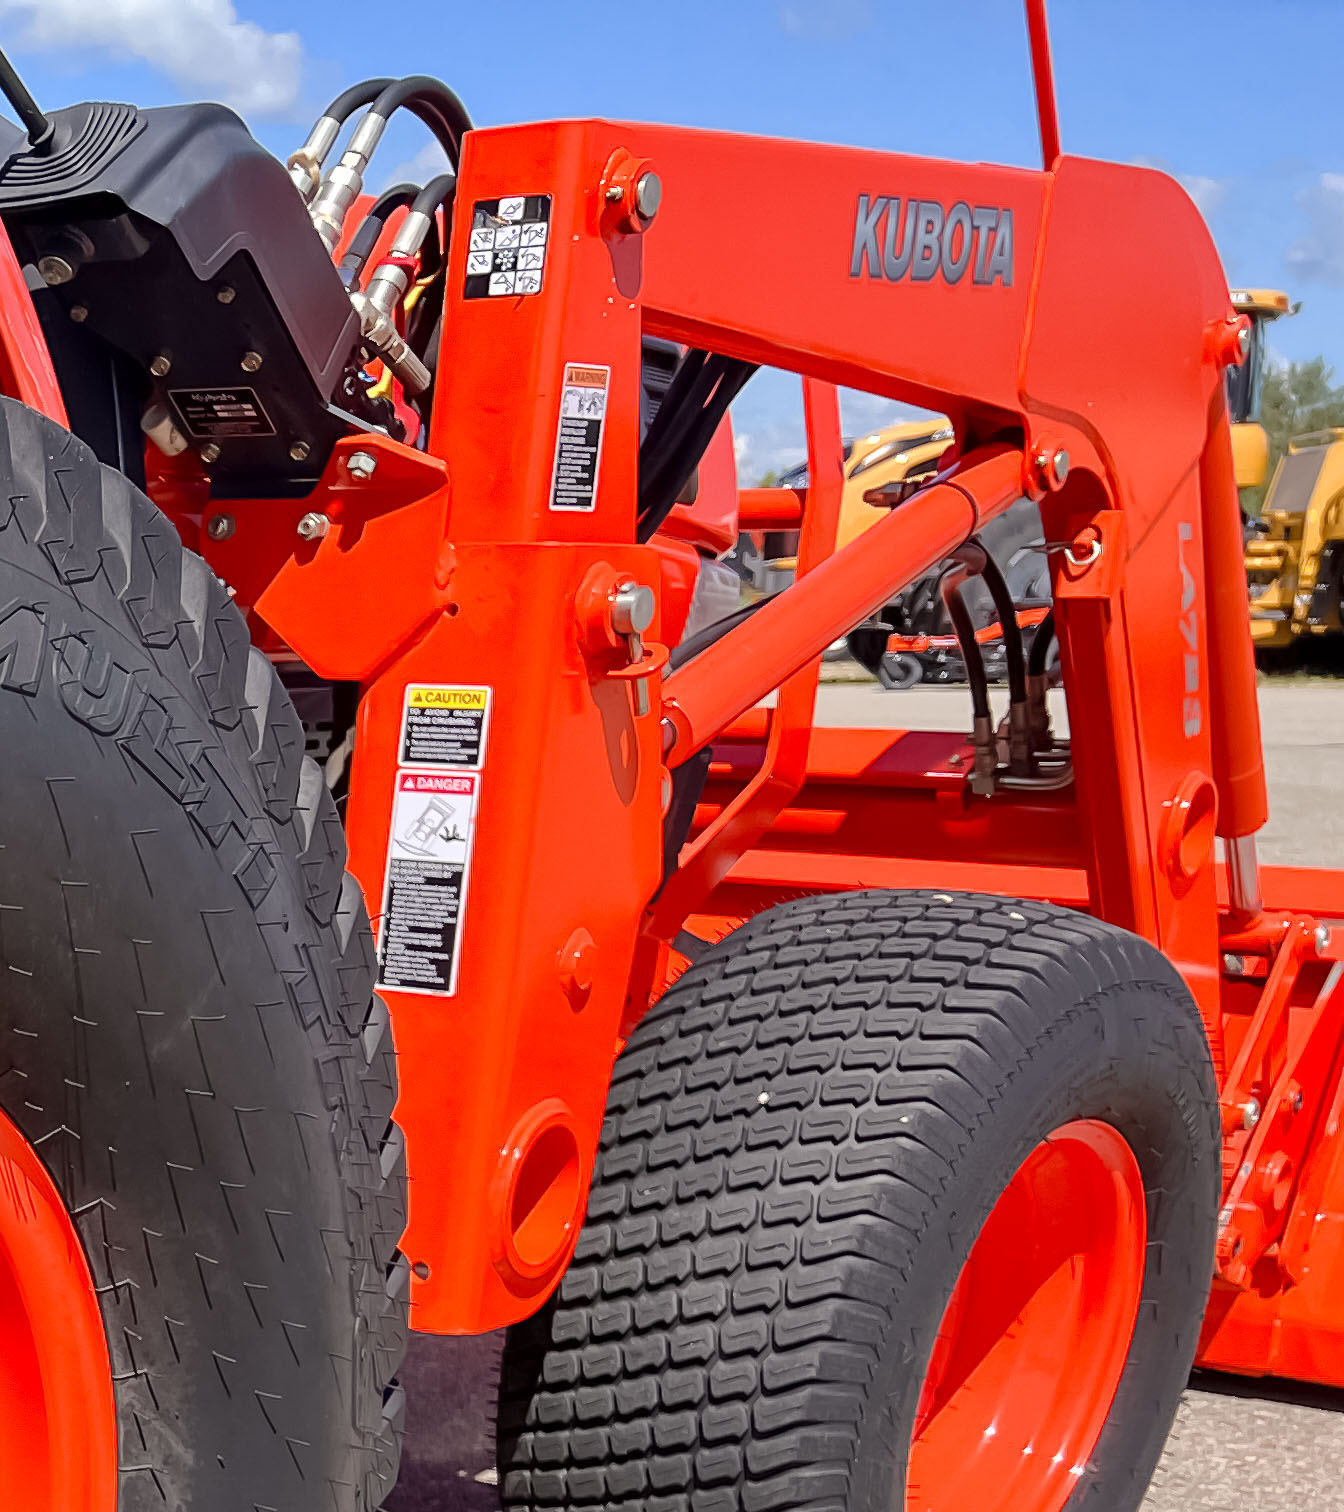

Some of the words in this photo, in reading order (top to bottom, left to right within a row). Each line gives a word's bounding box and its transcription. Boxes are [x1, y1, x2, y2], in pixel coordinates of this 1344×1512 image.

[850, 193, 1013, 287] KUBOTA
[425, 692, 481, 705] CAUTION
[416, 777, 472, 792] DANGER
